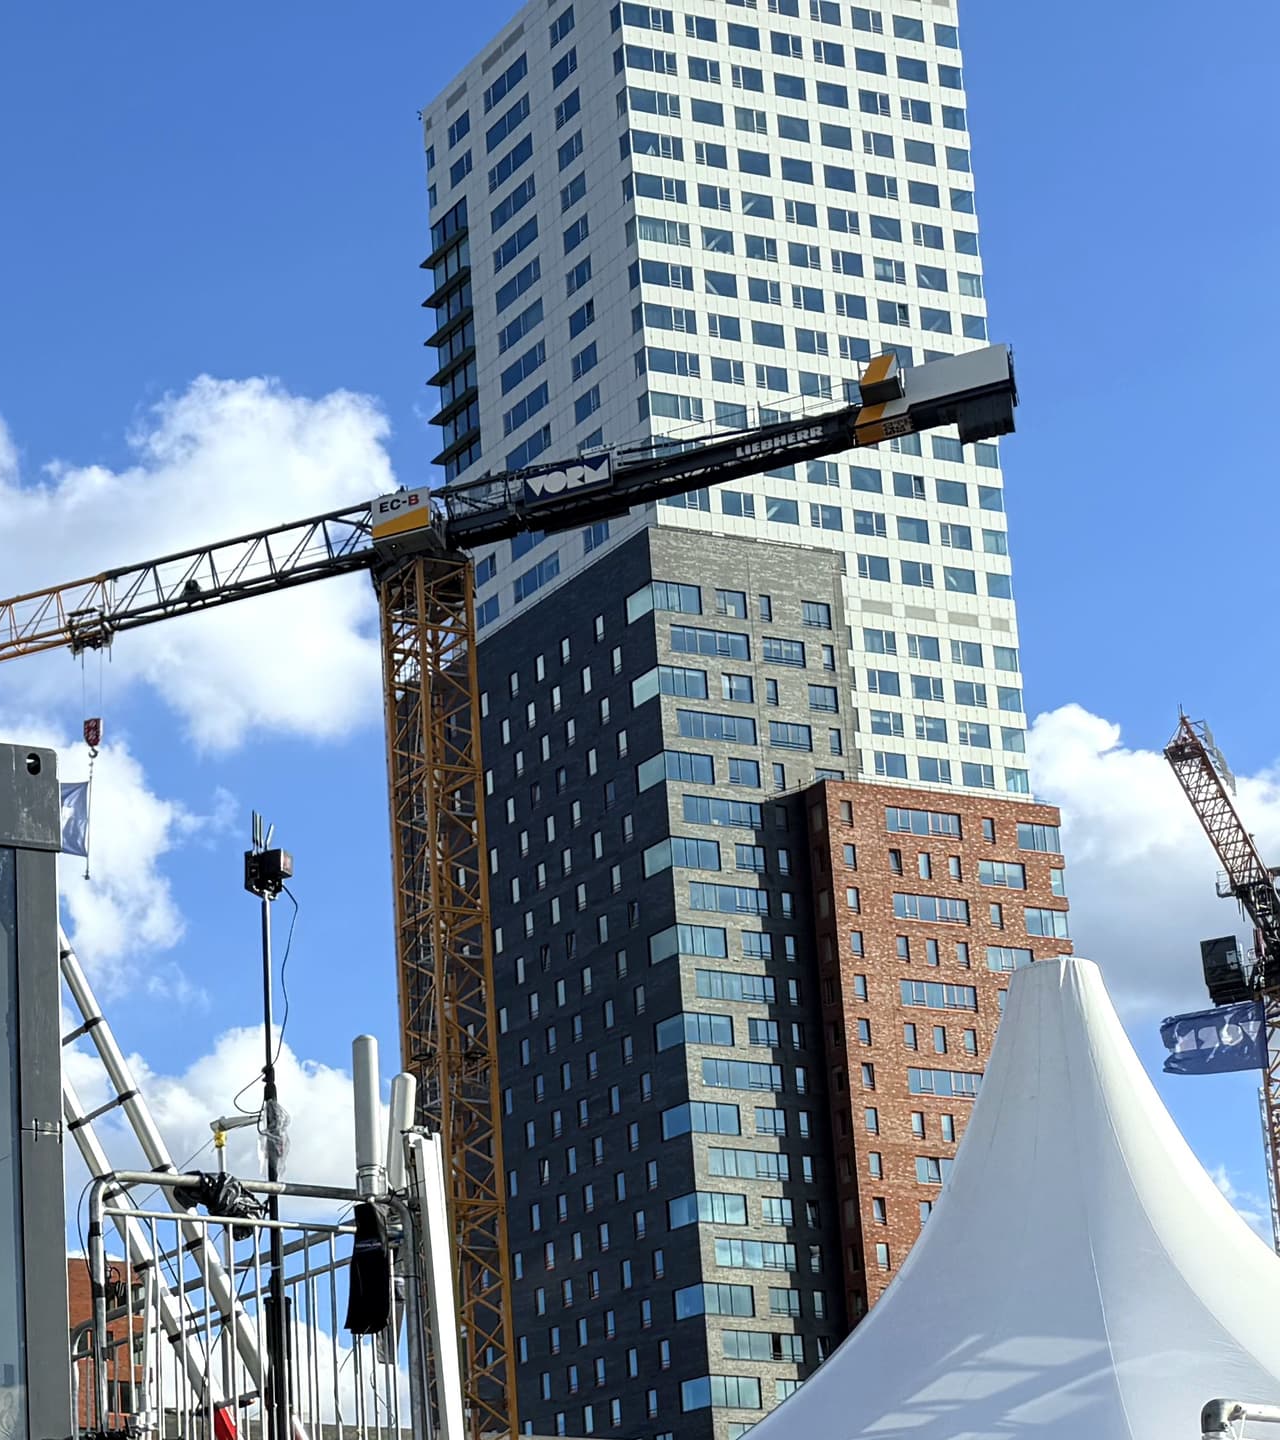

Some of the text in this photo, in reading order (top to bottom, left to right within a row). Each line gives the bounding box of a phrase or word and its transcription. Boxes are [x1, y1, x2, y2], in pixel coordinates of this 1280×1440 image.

[736, 425, 824, 458] LIEBHERR
[526, 458, 610, 497] VORM
[379, 494, 420, 513] EC-B
